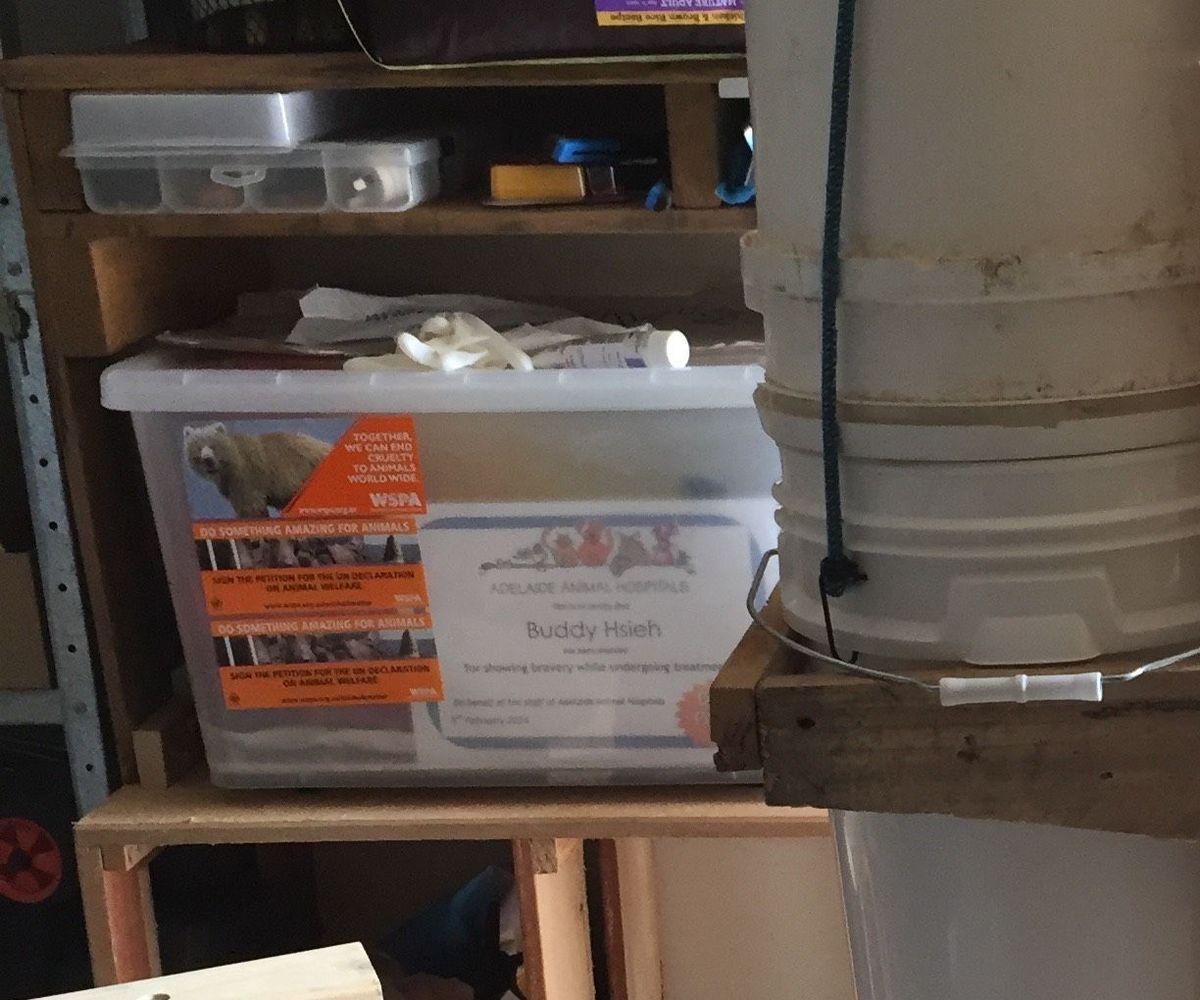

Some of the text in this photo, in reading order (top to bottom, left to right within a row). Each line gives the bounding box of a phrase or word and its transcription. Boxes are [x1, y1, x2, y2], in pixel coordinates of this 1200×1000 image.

[344, 442, 413, 453] WE CAN END
[367, 452, 414, 463] CRUELTY
[352, 463, 417, 473] TO ANIMALS
[369, 492, 422, 508] WSPA
[200, 521, 410, 538] DO SOMETHING AMAZING FOR ANIMALS
[212, 576, 234, 584] SIGN
[236, 575, 254, 583] THE
[255, 574, 296, 583] PETITION
[298, 573, 316, 581] FOR
[317, 573, 334, 581] THE
[351, 570, 415, 580] DECLARATION
[282, 583, 318, 592] ANIMAL
[320, 582, 363, 591] WELFARE
[490, 580, 689, 595] ADELAIDE ANIMAL HOSPITALS
[218, 617, 425, 634] DO SOMETHING AMAZING FOR ANIMALS
[527, 620, 662, 641] Buddy Hsieh
[230, 671, 252, 680] SIGN
[254, 671, 270, 680] THE
[272, 669, 312, 679] PETITION
[314, 668, 332, 677] FOR
[334, 668, 351, 676] THE
[368, 665, 430, 676] DECLARATION
[577, 661, 606, 672] while
[299, 678, 336, 687] ANIMAL
[338, 676, 379, 686] WELFARE
